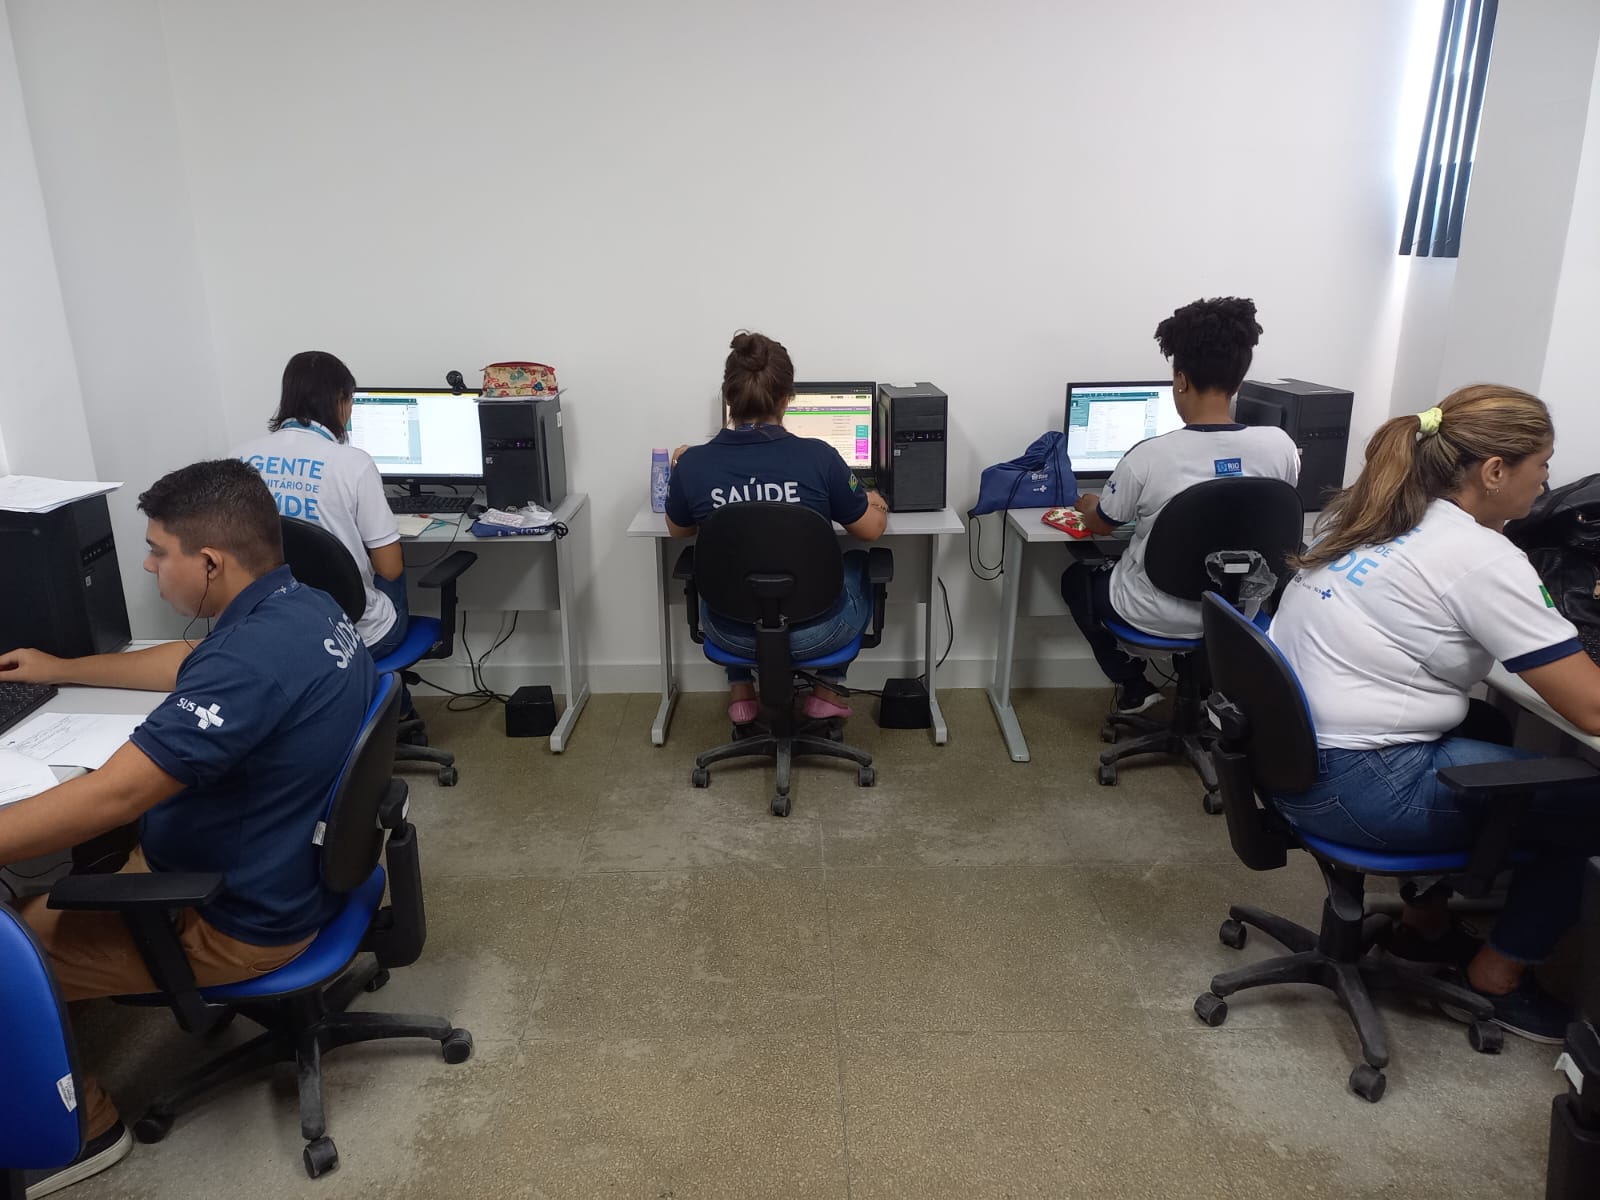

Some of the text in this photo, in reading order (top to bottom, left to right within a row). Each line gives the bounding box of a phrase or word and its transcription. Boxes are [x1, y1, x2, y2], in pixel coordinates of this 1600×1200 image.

[240, 455, 324, 480] GENTE
[305, 483, 320, 494] DE
[711, 477, 801, 509] SAÚDE
[1374, 544, 1393, 558] DE
[176, 697, 197, 712] SUS
